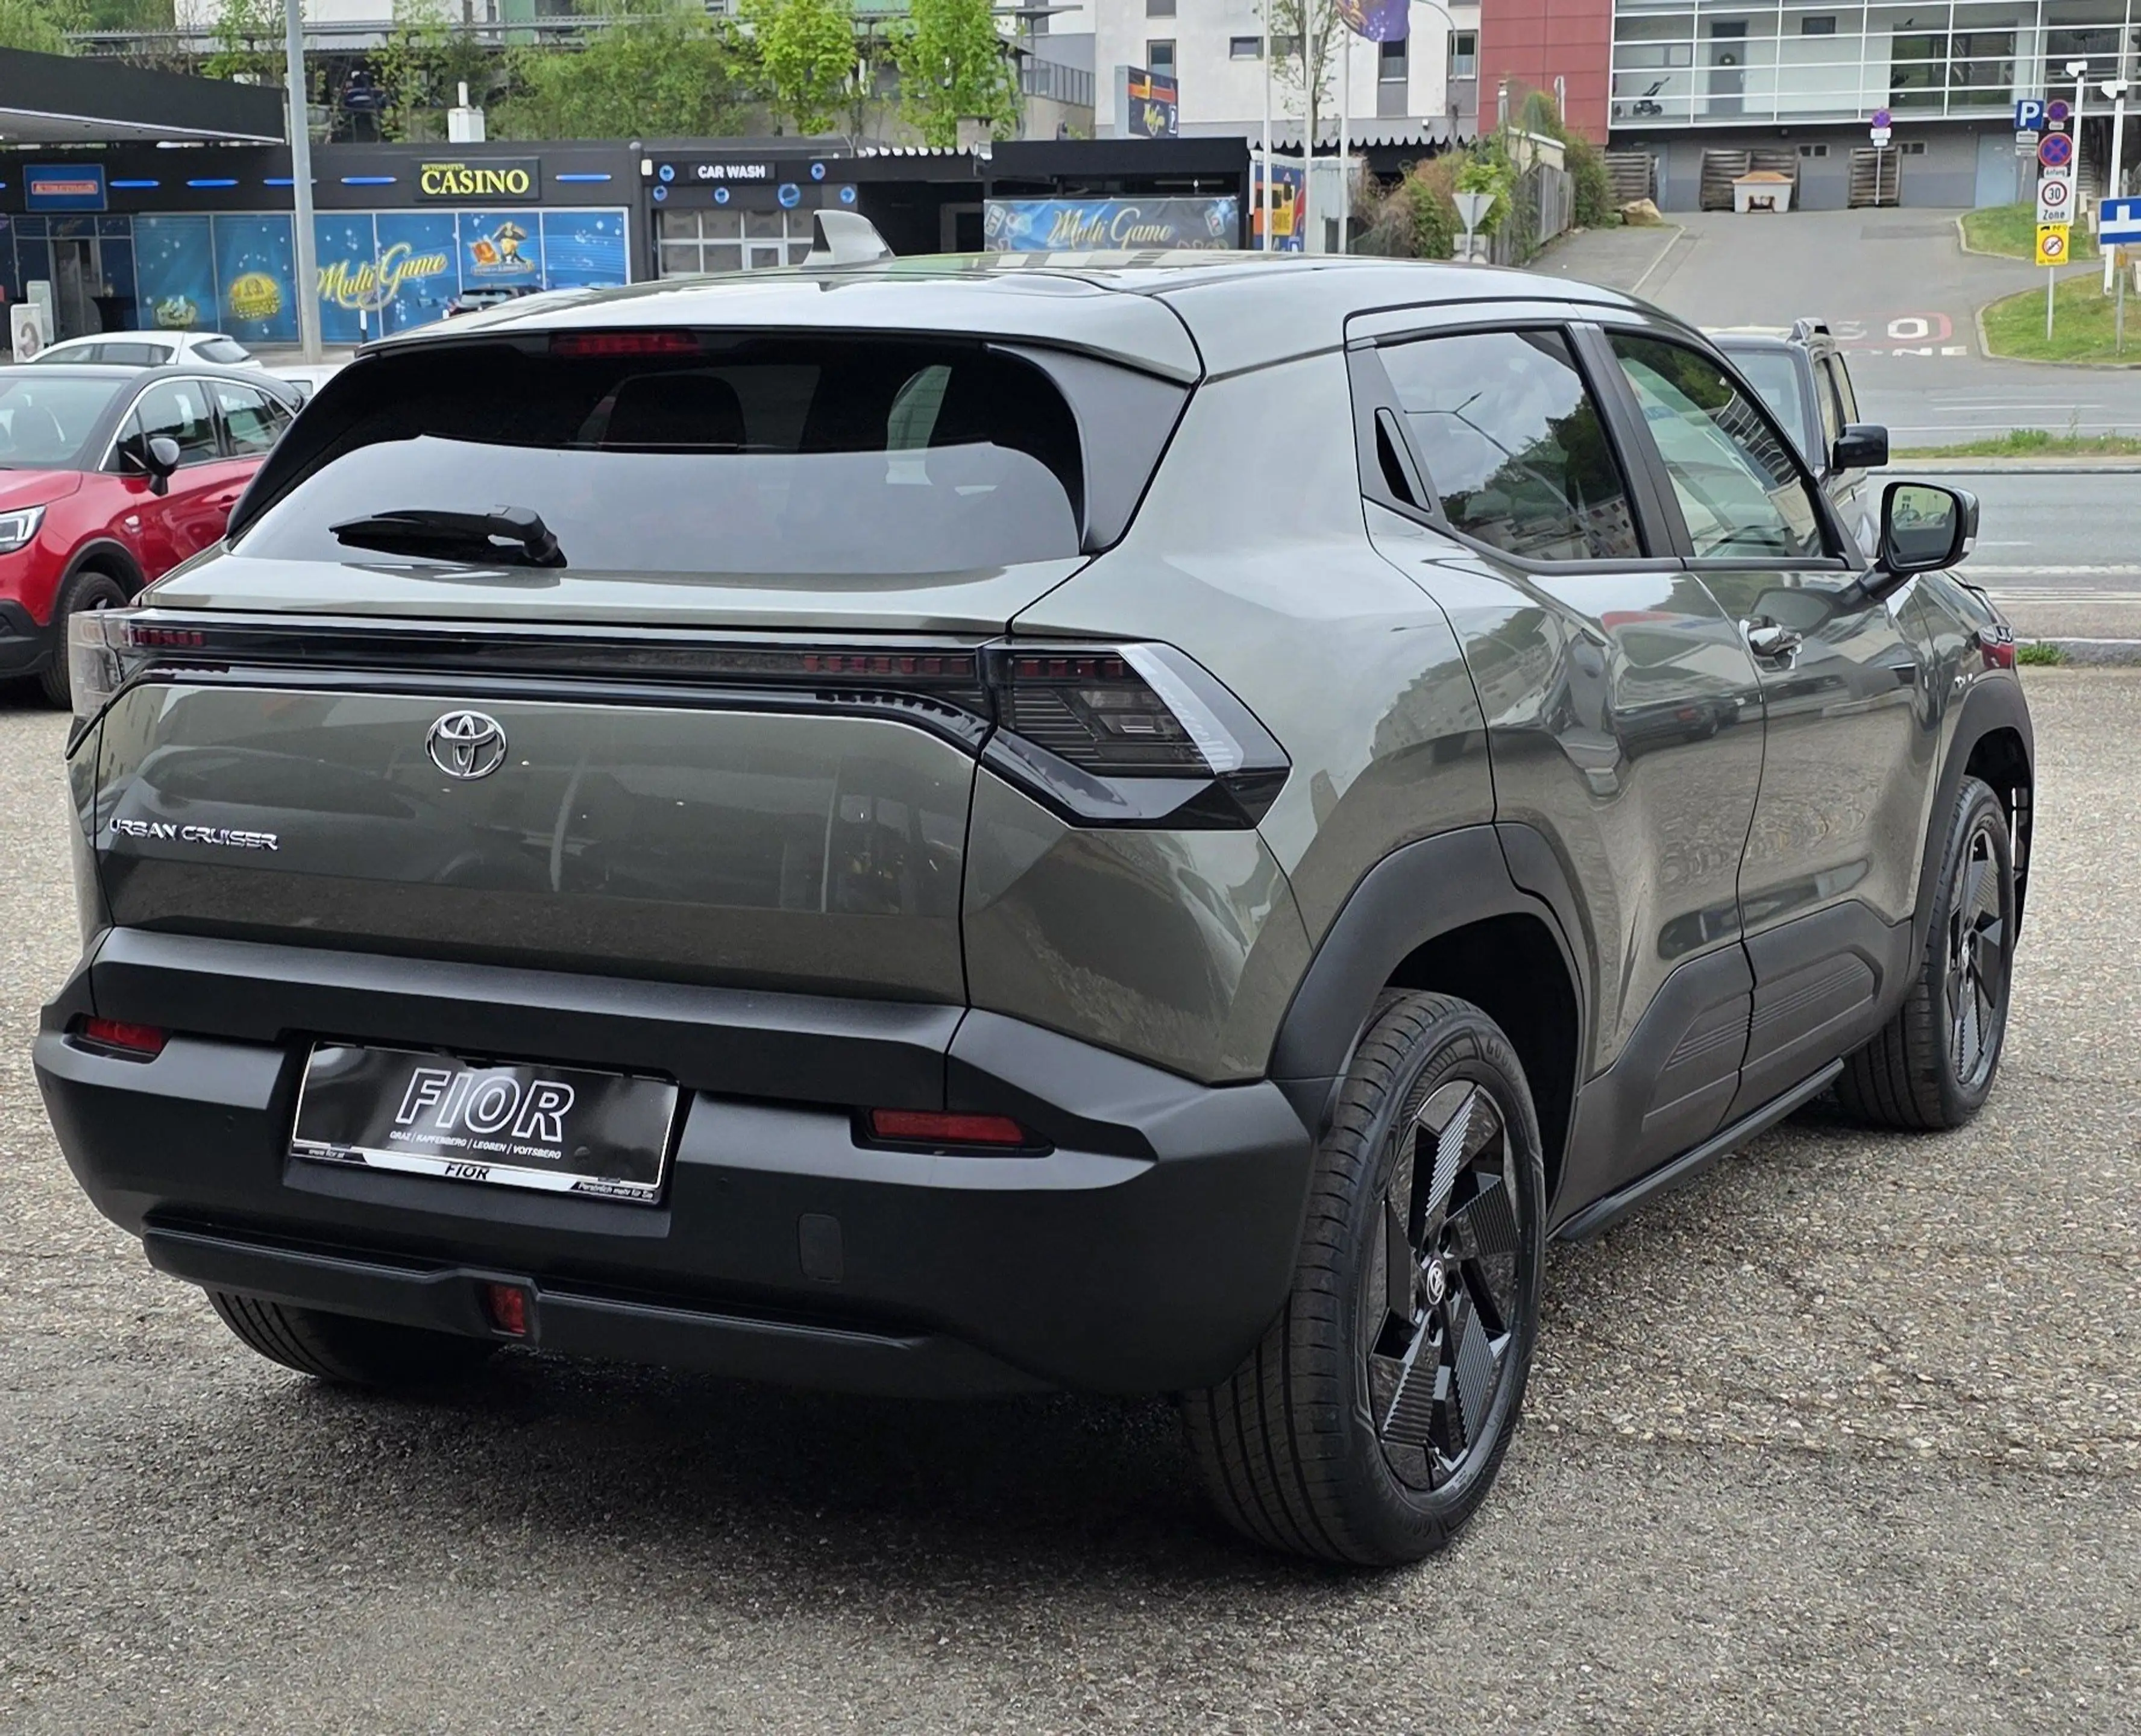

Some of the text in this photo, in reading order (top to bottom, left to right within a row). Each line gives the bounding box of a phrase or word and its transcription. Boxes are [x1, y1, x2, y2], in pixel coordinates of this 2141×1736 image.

[421, 169, 529, 195] CASINO
[697, 165, 766, 178] CAR WASH
[2048, 187, 2060, 200] 30
[2043, 209, 2065, 220] Zone
[1046, 207, 1107, 250] Multi
[1109, 207, 1172, 251] Game
[110, 819, 278, 850] URBAN CRUISER
[395, 1068, 574, 1142] FIOR
[389, 1131, 412, 1142] GRAZ
[416, 1133, 467, 1147] KAPFENBERG
[473, 1140, 506, 1153] LEOBEN
[512, 1145, 562, 1160] VOITSBERG
[445, 1163, 489, 1180] FIOR
